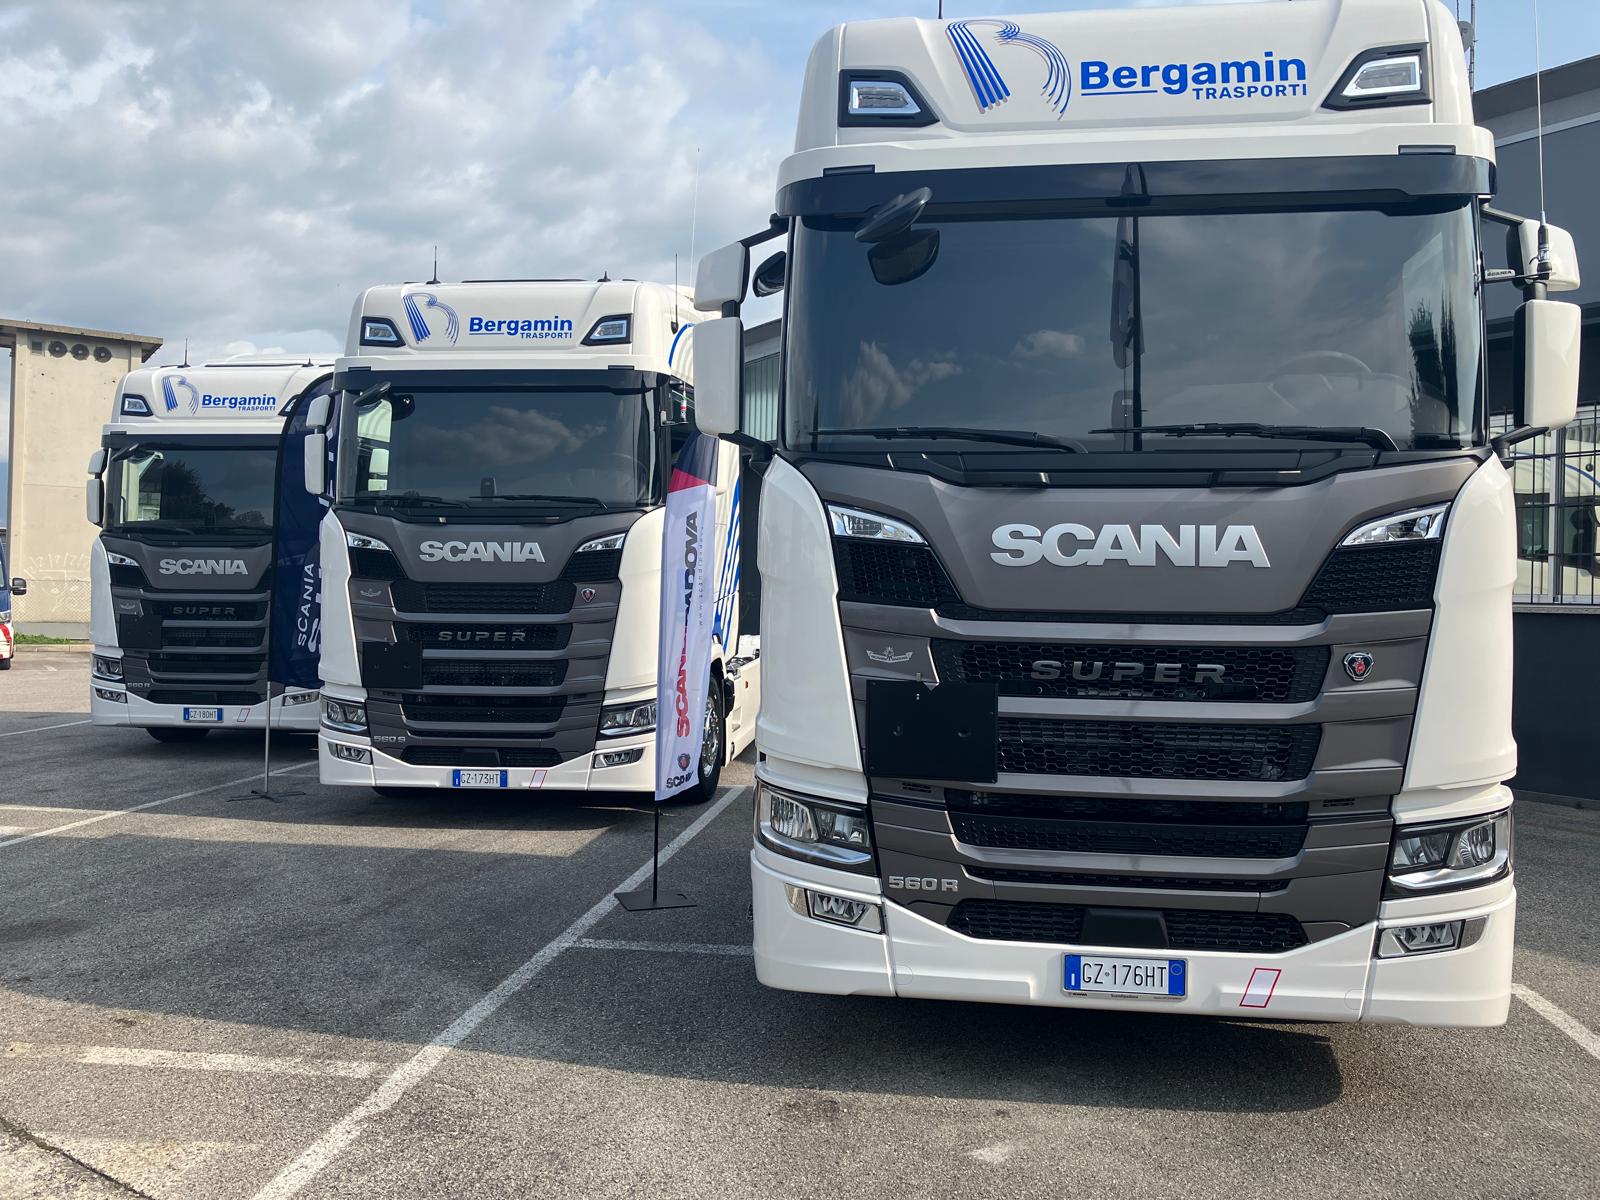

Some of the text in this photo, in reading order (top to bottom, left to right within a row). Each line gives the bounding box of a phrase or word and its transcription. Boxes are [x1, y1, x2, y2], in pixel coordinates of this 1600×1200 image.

[1080, 51, 1307, 95] Bergamin
[1192, 83, 1308, 100] TRASPORTI
[469, 315, 573, 336] Bergamin
[520, 332, 573, 340] TRASPORTI
[201, 394, 276, 409] Bergamin
[419, 540, 546, 563] SCANIA
[990, 523, 1271, 568] SCANIA
[159, 558, 249, 575] SCANIA
[172, 606, 236, 615] SUPER
[297, 563, 315, 647] SCANIA
[438, 631, 527, 642] SUPER
[1030, 660, 1227, 685] SUPER
